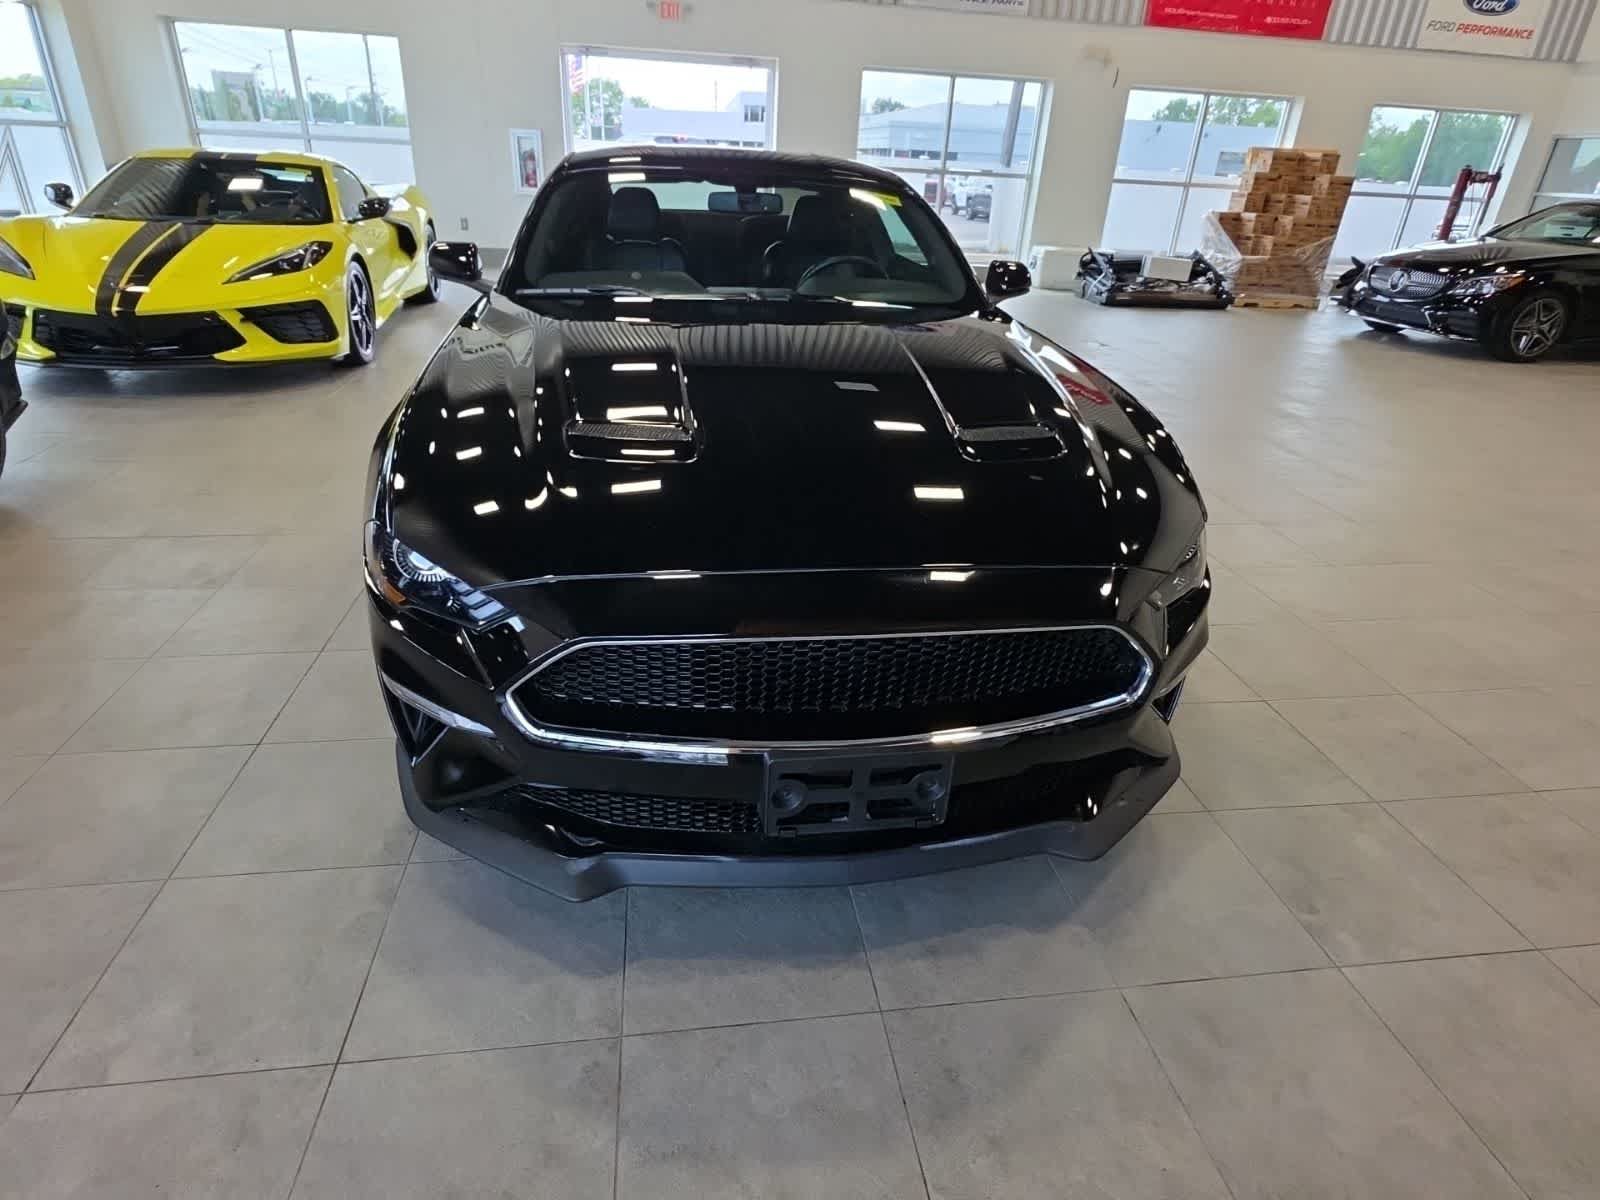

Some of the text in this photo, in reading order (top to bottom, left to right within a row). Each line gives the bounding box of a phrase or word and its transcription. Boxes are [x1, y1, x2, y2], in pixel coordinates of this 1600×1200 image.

[660, 2, 680, 19] EXIT
[1425, 20, 1535, 40] FORD PERFORMANCE
